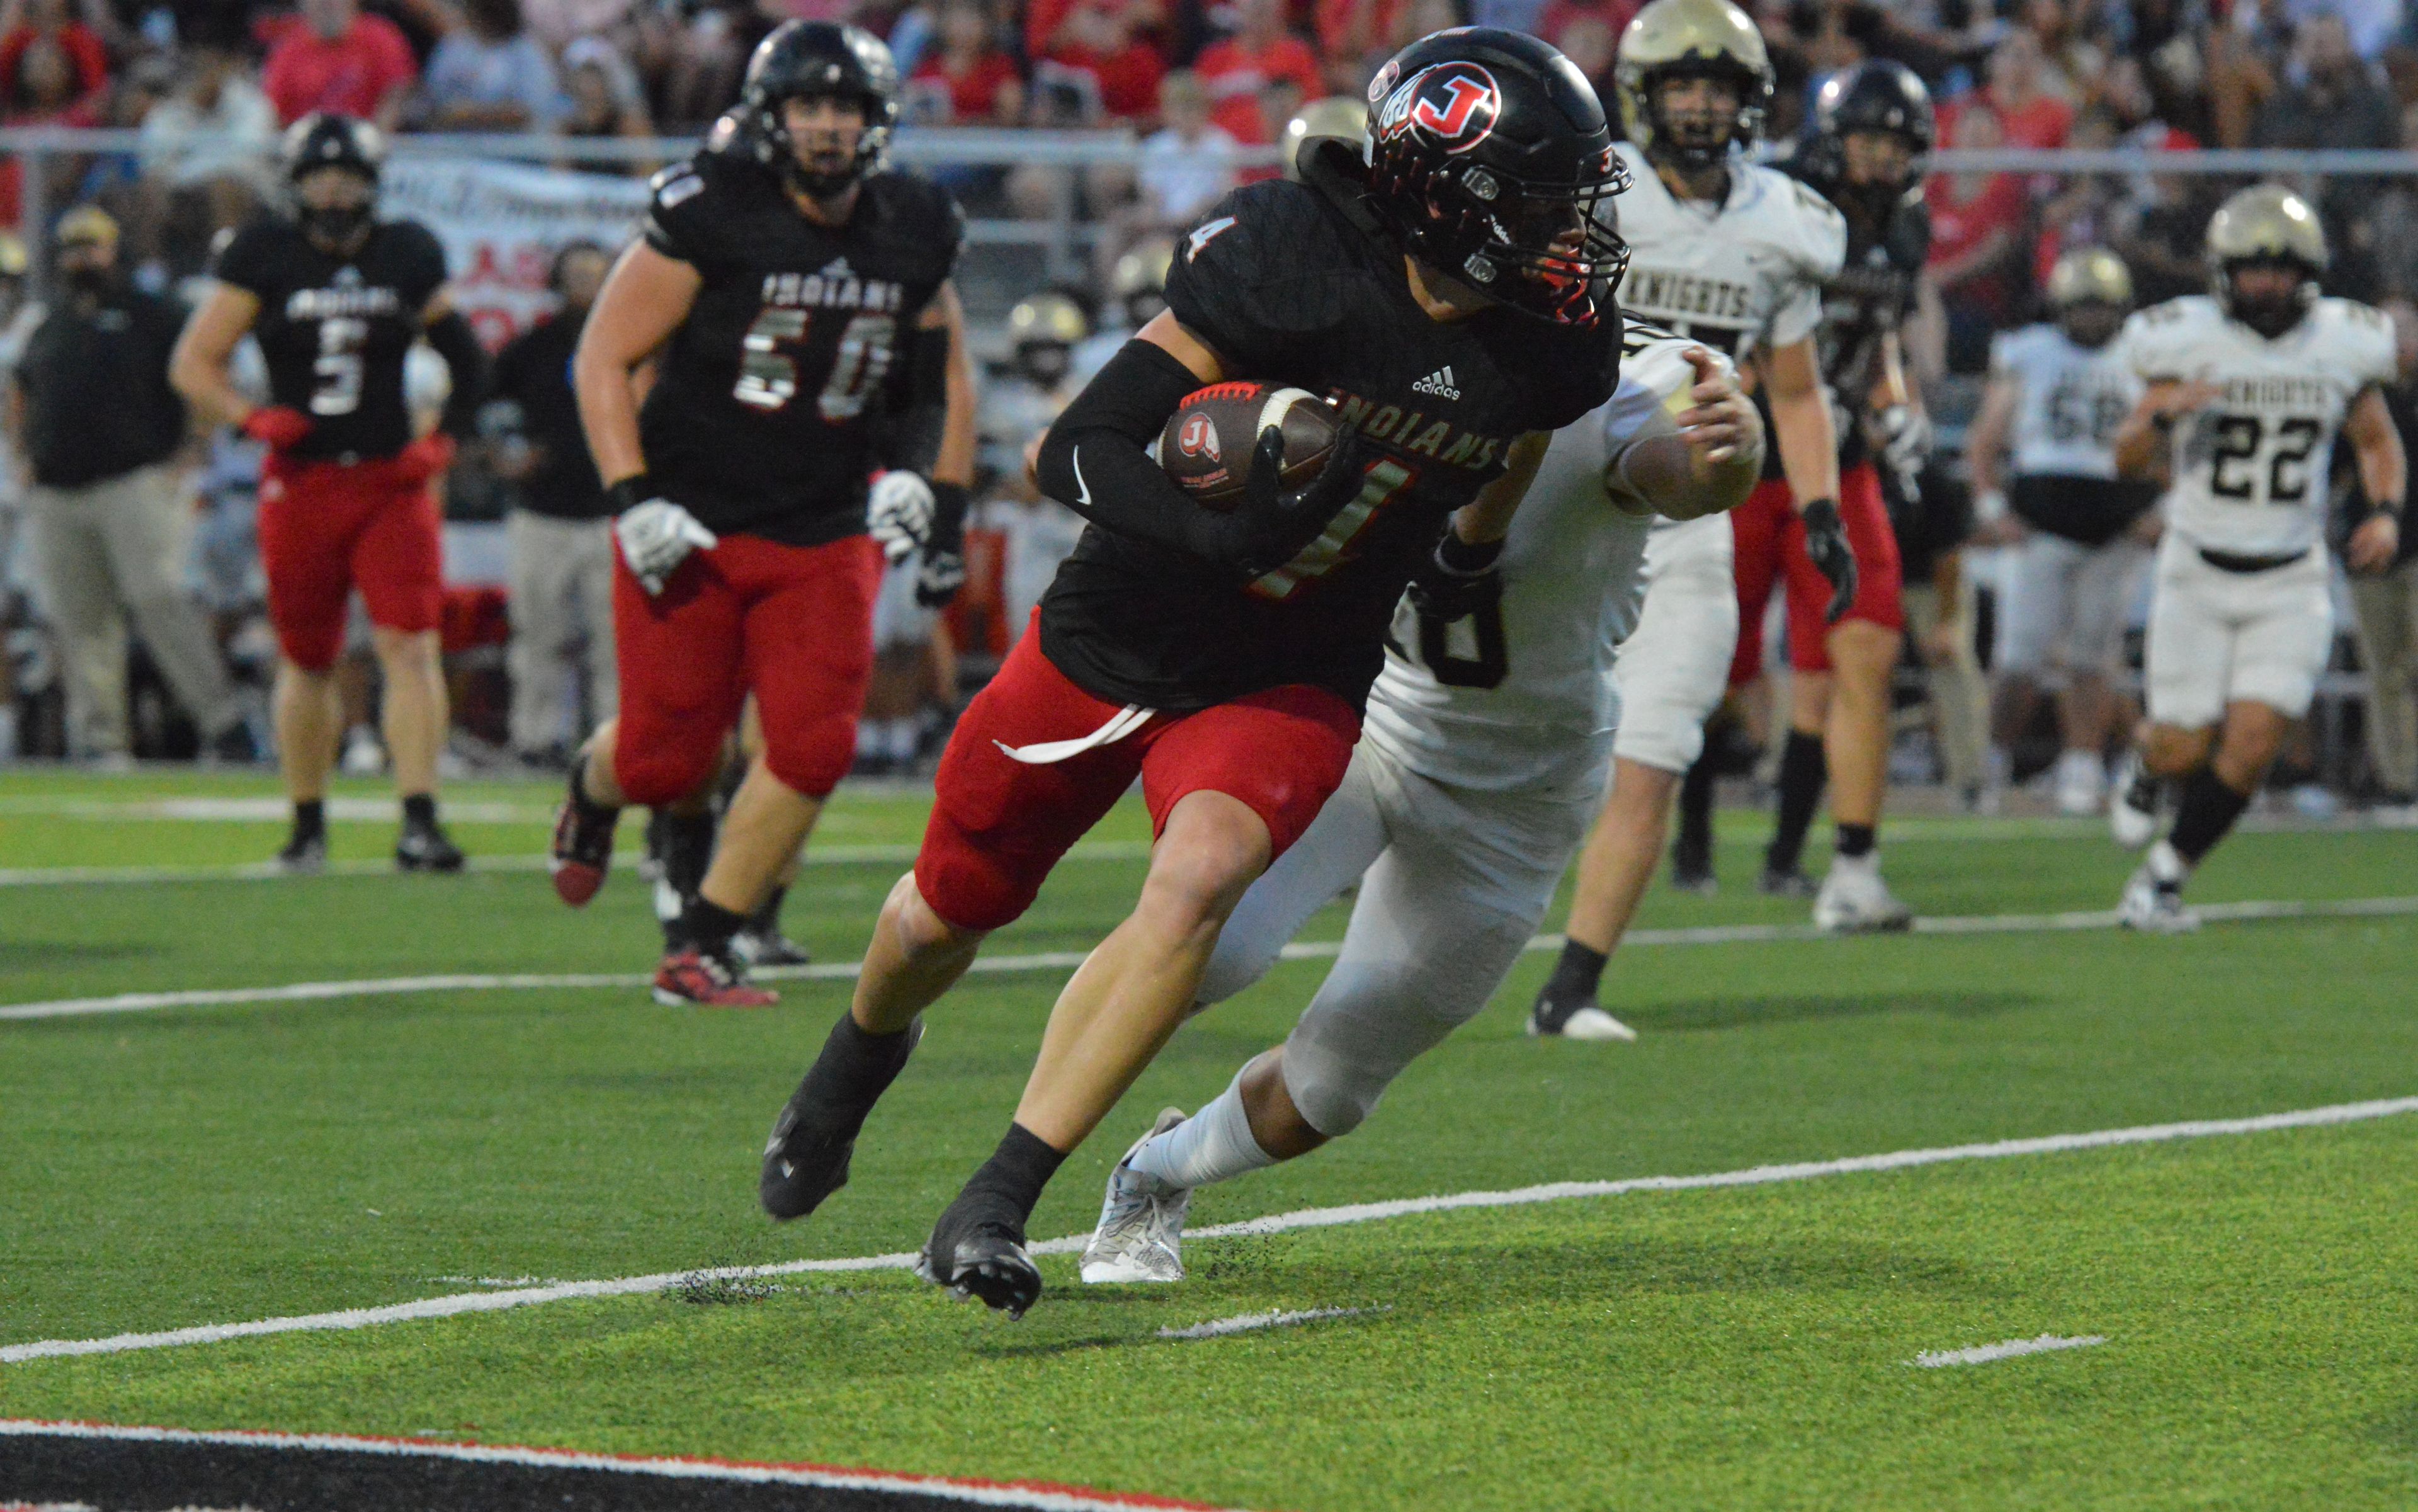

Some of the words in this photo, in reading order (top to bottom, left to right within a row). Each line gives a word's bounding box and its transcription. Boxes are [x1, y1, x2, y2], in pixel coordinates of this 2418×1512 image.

[1412, 75, 1492, 138] J
[1186, 214, 1239, 264] 4
[1622, 265, 1752, 318] KNIGHTS
[310, 317, 370, 416] 5
[1412, 380, 1461, 401] adidas
[2211, 412, 2322, 501] 22
